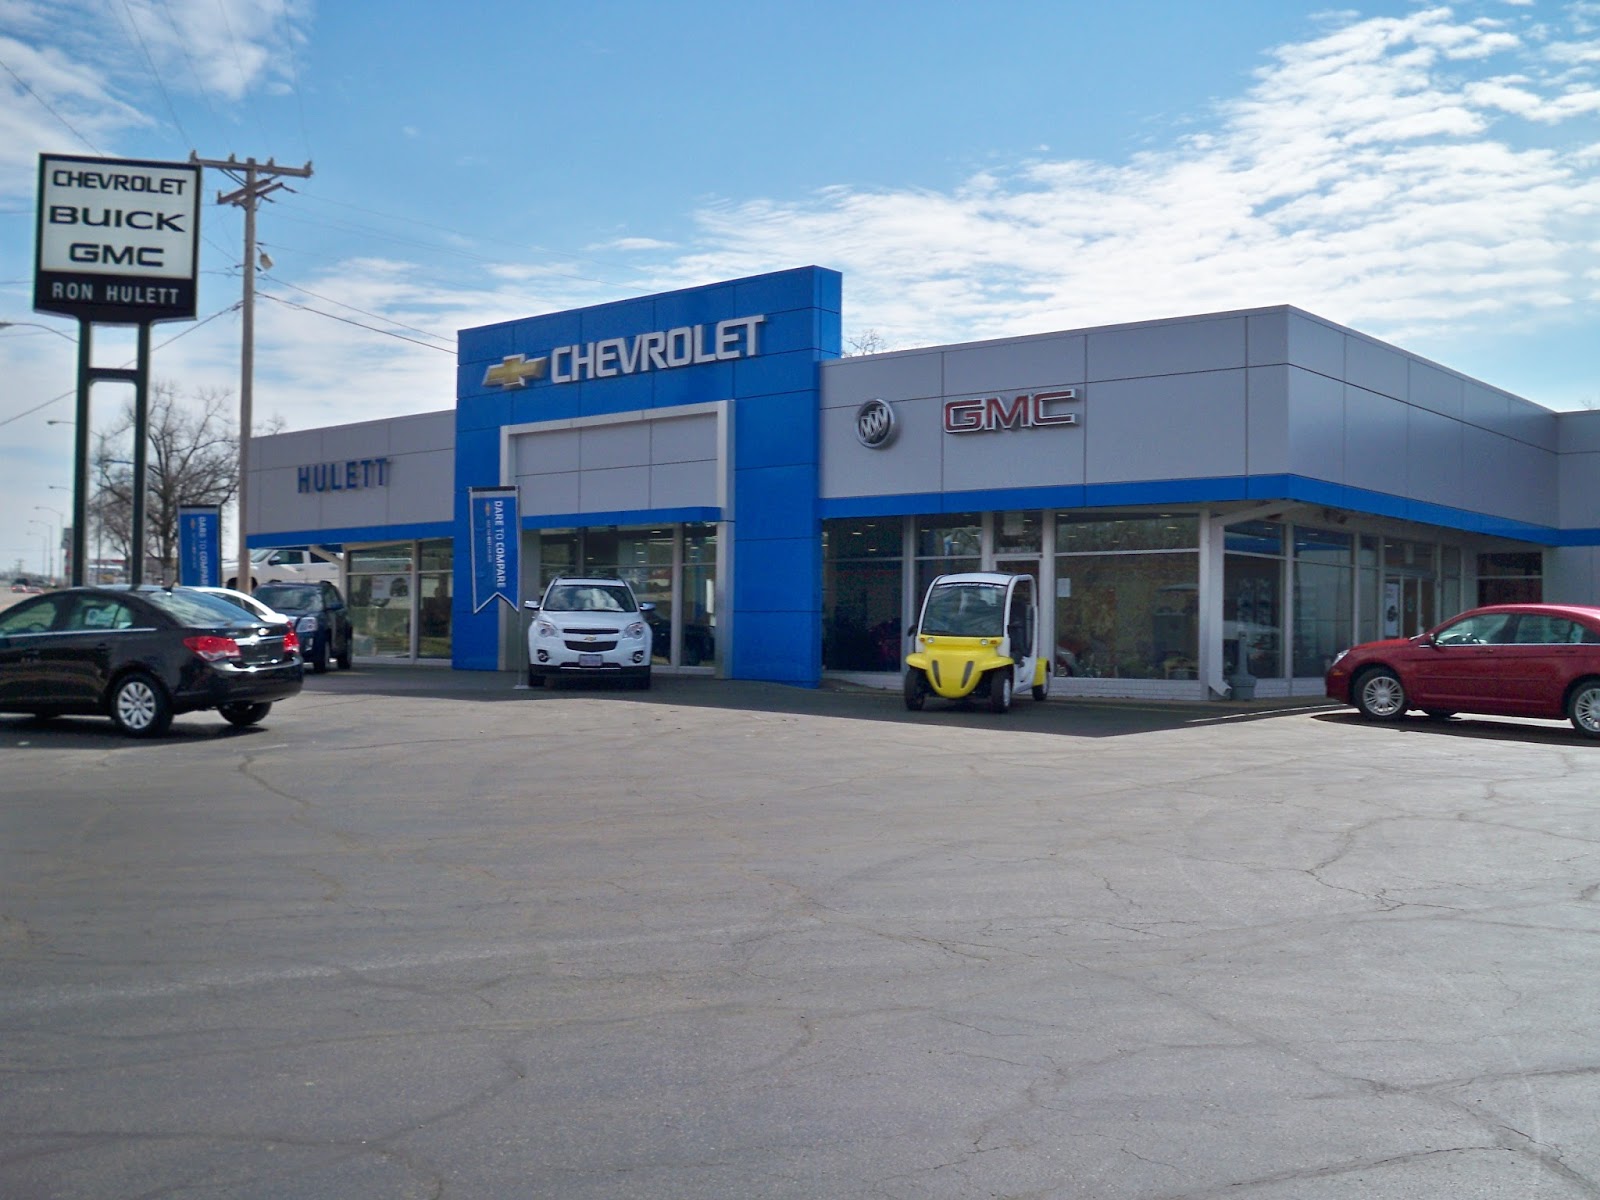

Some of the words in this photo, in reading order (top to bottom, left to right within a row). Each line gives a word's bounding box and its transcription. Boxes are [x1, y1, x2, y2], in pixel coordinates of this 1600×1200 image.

[52, 169, 187, 195] CHEVROLET
[49, 205, 186, 232] BUICK
[69, 242, 164, 267] GMC
[52, 282, 94, 300] RON
[106, 285, 179, 304] HULETT
[551, 314, 765, 384] CHEVROLET
[944, 388, 1076, 433] GMC
[297, 457, 388, 494] HULETT
[494, 500, 504, 526] DARE
[494, 528, 505, 540] TO
[200, 551, 208, 586] COMPAR
[495, 542, 507, 588] COMPARE
